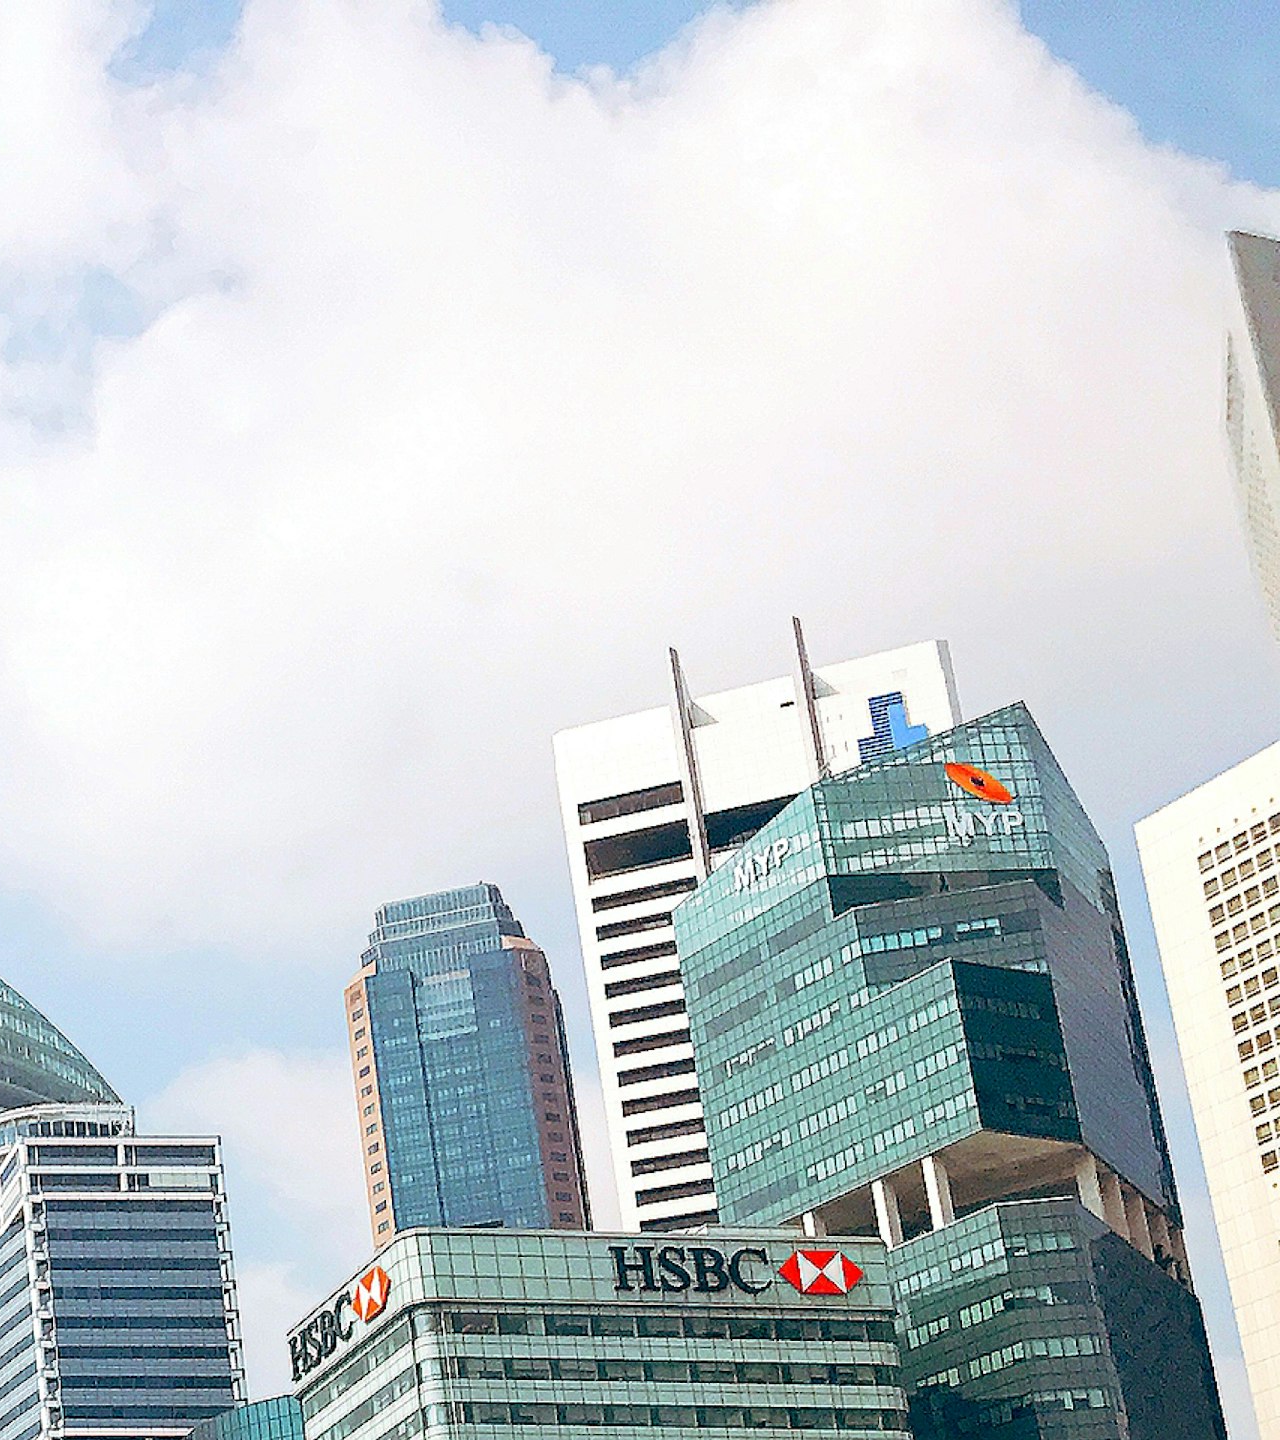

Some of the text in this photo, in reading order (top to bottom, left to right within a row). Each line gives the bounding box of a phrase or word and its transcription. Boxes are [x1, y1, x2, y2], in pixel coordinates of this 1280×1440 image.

[944, 807, 1023, 836] MYP
[734, 838, 789, 892] MYP
[608, 1245, 772, 1295] HSBC
[288, 1290, 352, 1382] HSBC
